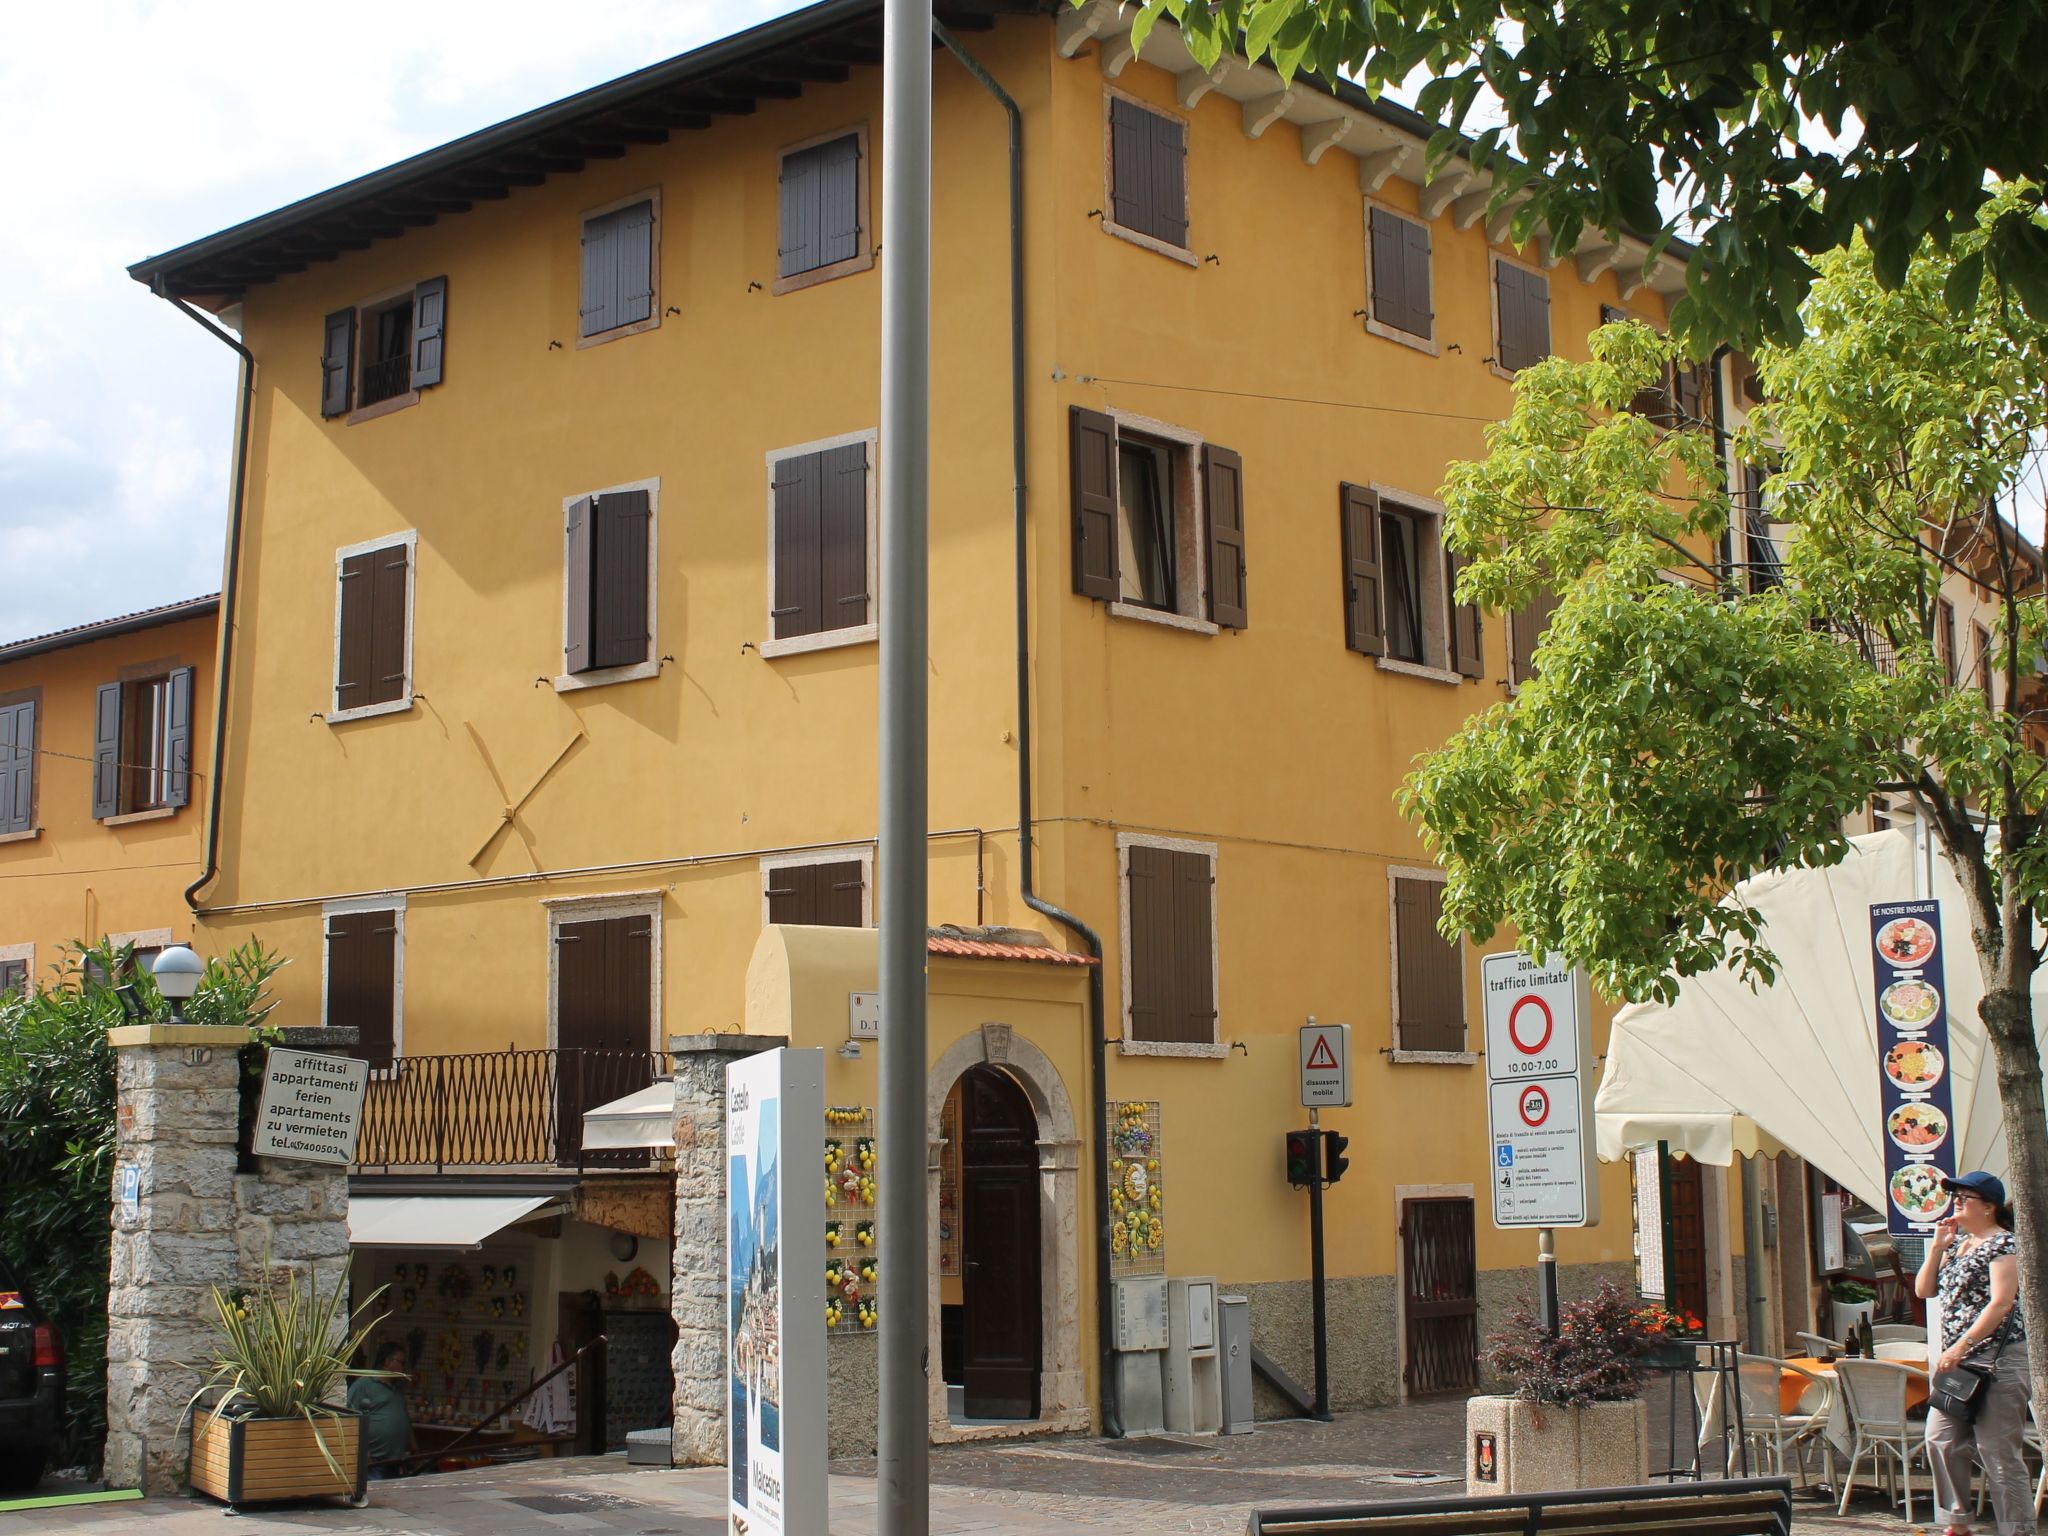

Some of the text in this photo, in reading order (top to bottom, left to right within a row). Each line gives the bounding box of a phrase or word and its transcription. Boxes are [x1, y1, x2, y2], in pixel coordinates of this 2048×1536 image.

[1873, 905, 1935, 916] LE NOSTRE INSALATE
[1490, 970, 1568, 992] traffico limitato
[294, 1057, 348, 1075] affittasi
[271, 1071, 359, 1092] appartamenti
[295, 1089, 332, 1105] ferien
[730, 1082, 750, 1114] Castello
[269, 1104, 352, 1124] apartaments
[266, 1121, 348, 1140] zu vermieten
[752, 1459, 781, 1503] Malcesine
